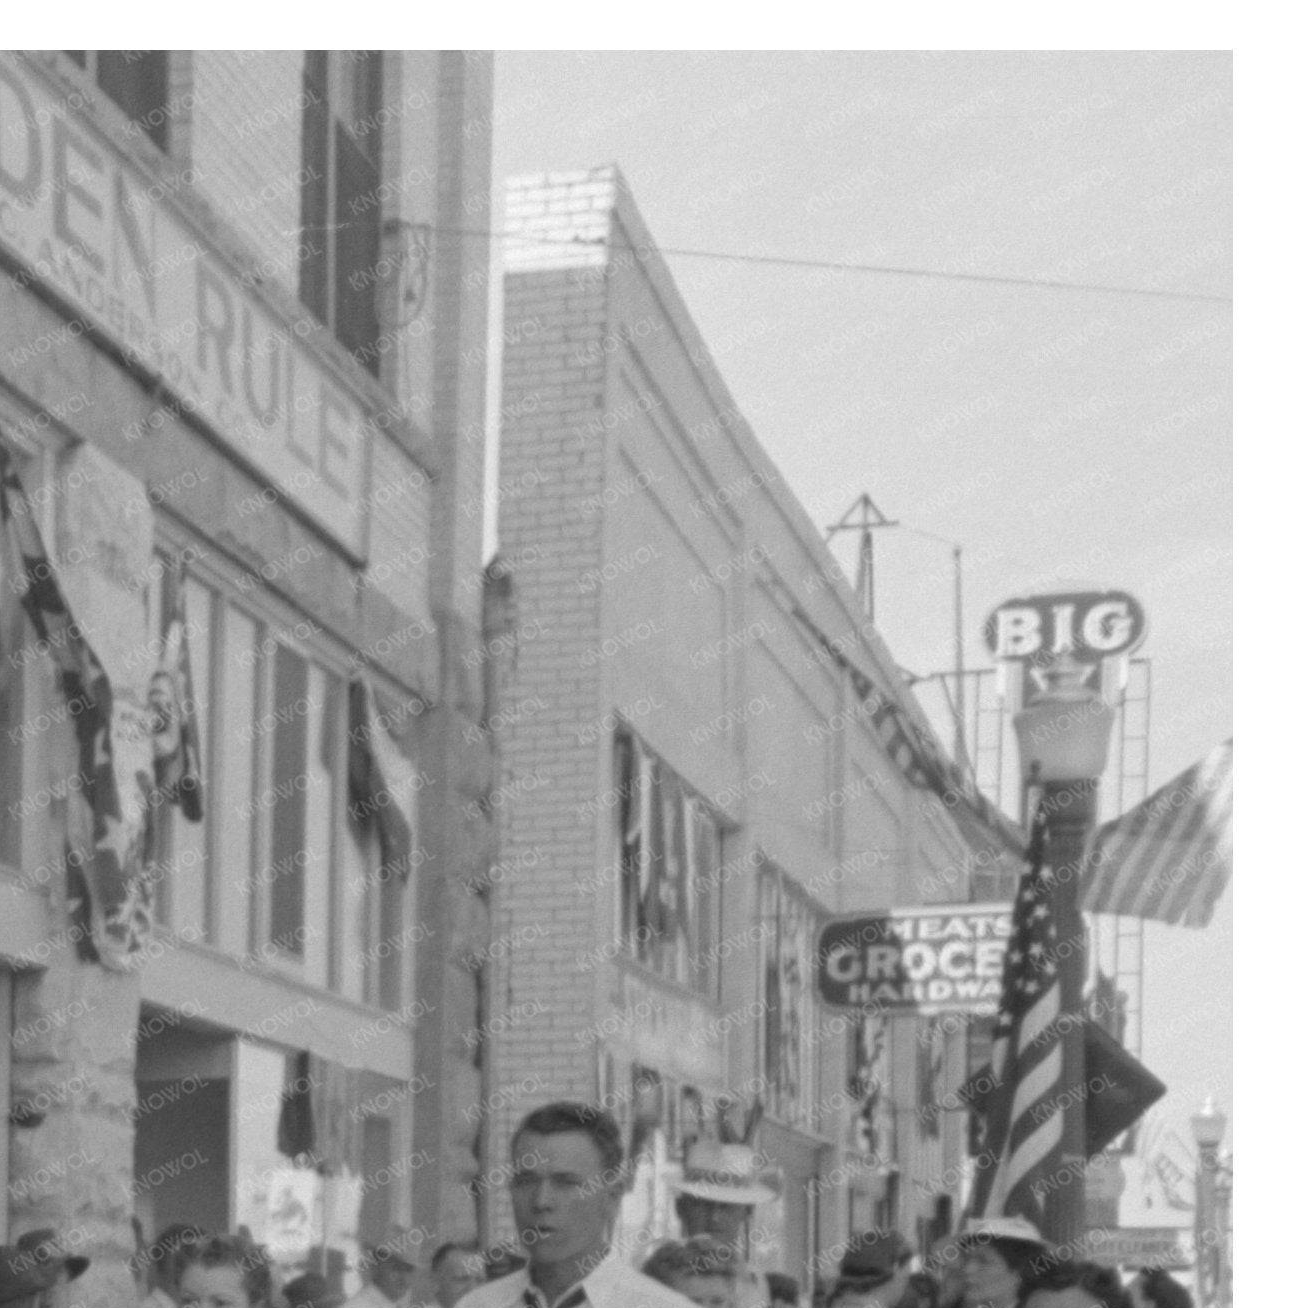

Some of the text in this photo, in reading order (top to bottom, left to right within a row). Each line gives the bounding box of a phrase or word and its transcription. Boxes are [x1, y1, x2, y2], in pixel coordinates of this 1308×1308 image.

[197, 256, 352, 501] RULE
[997, 602, 1133, 658] BIG
[885, 915, 1014, 940] MEATS
